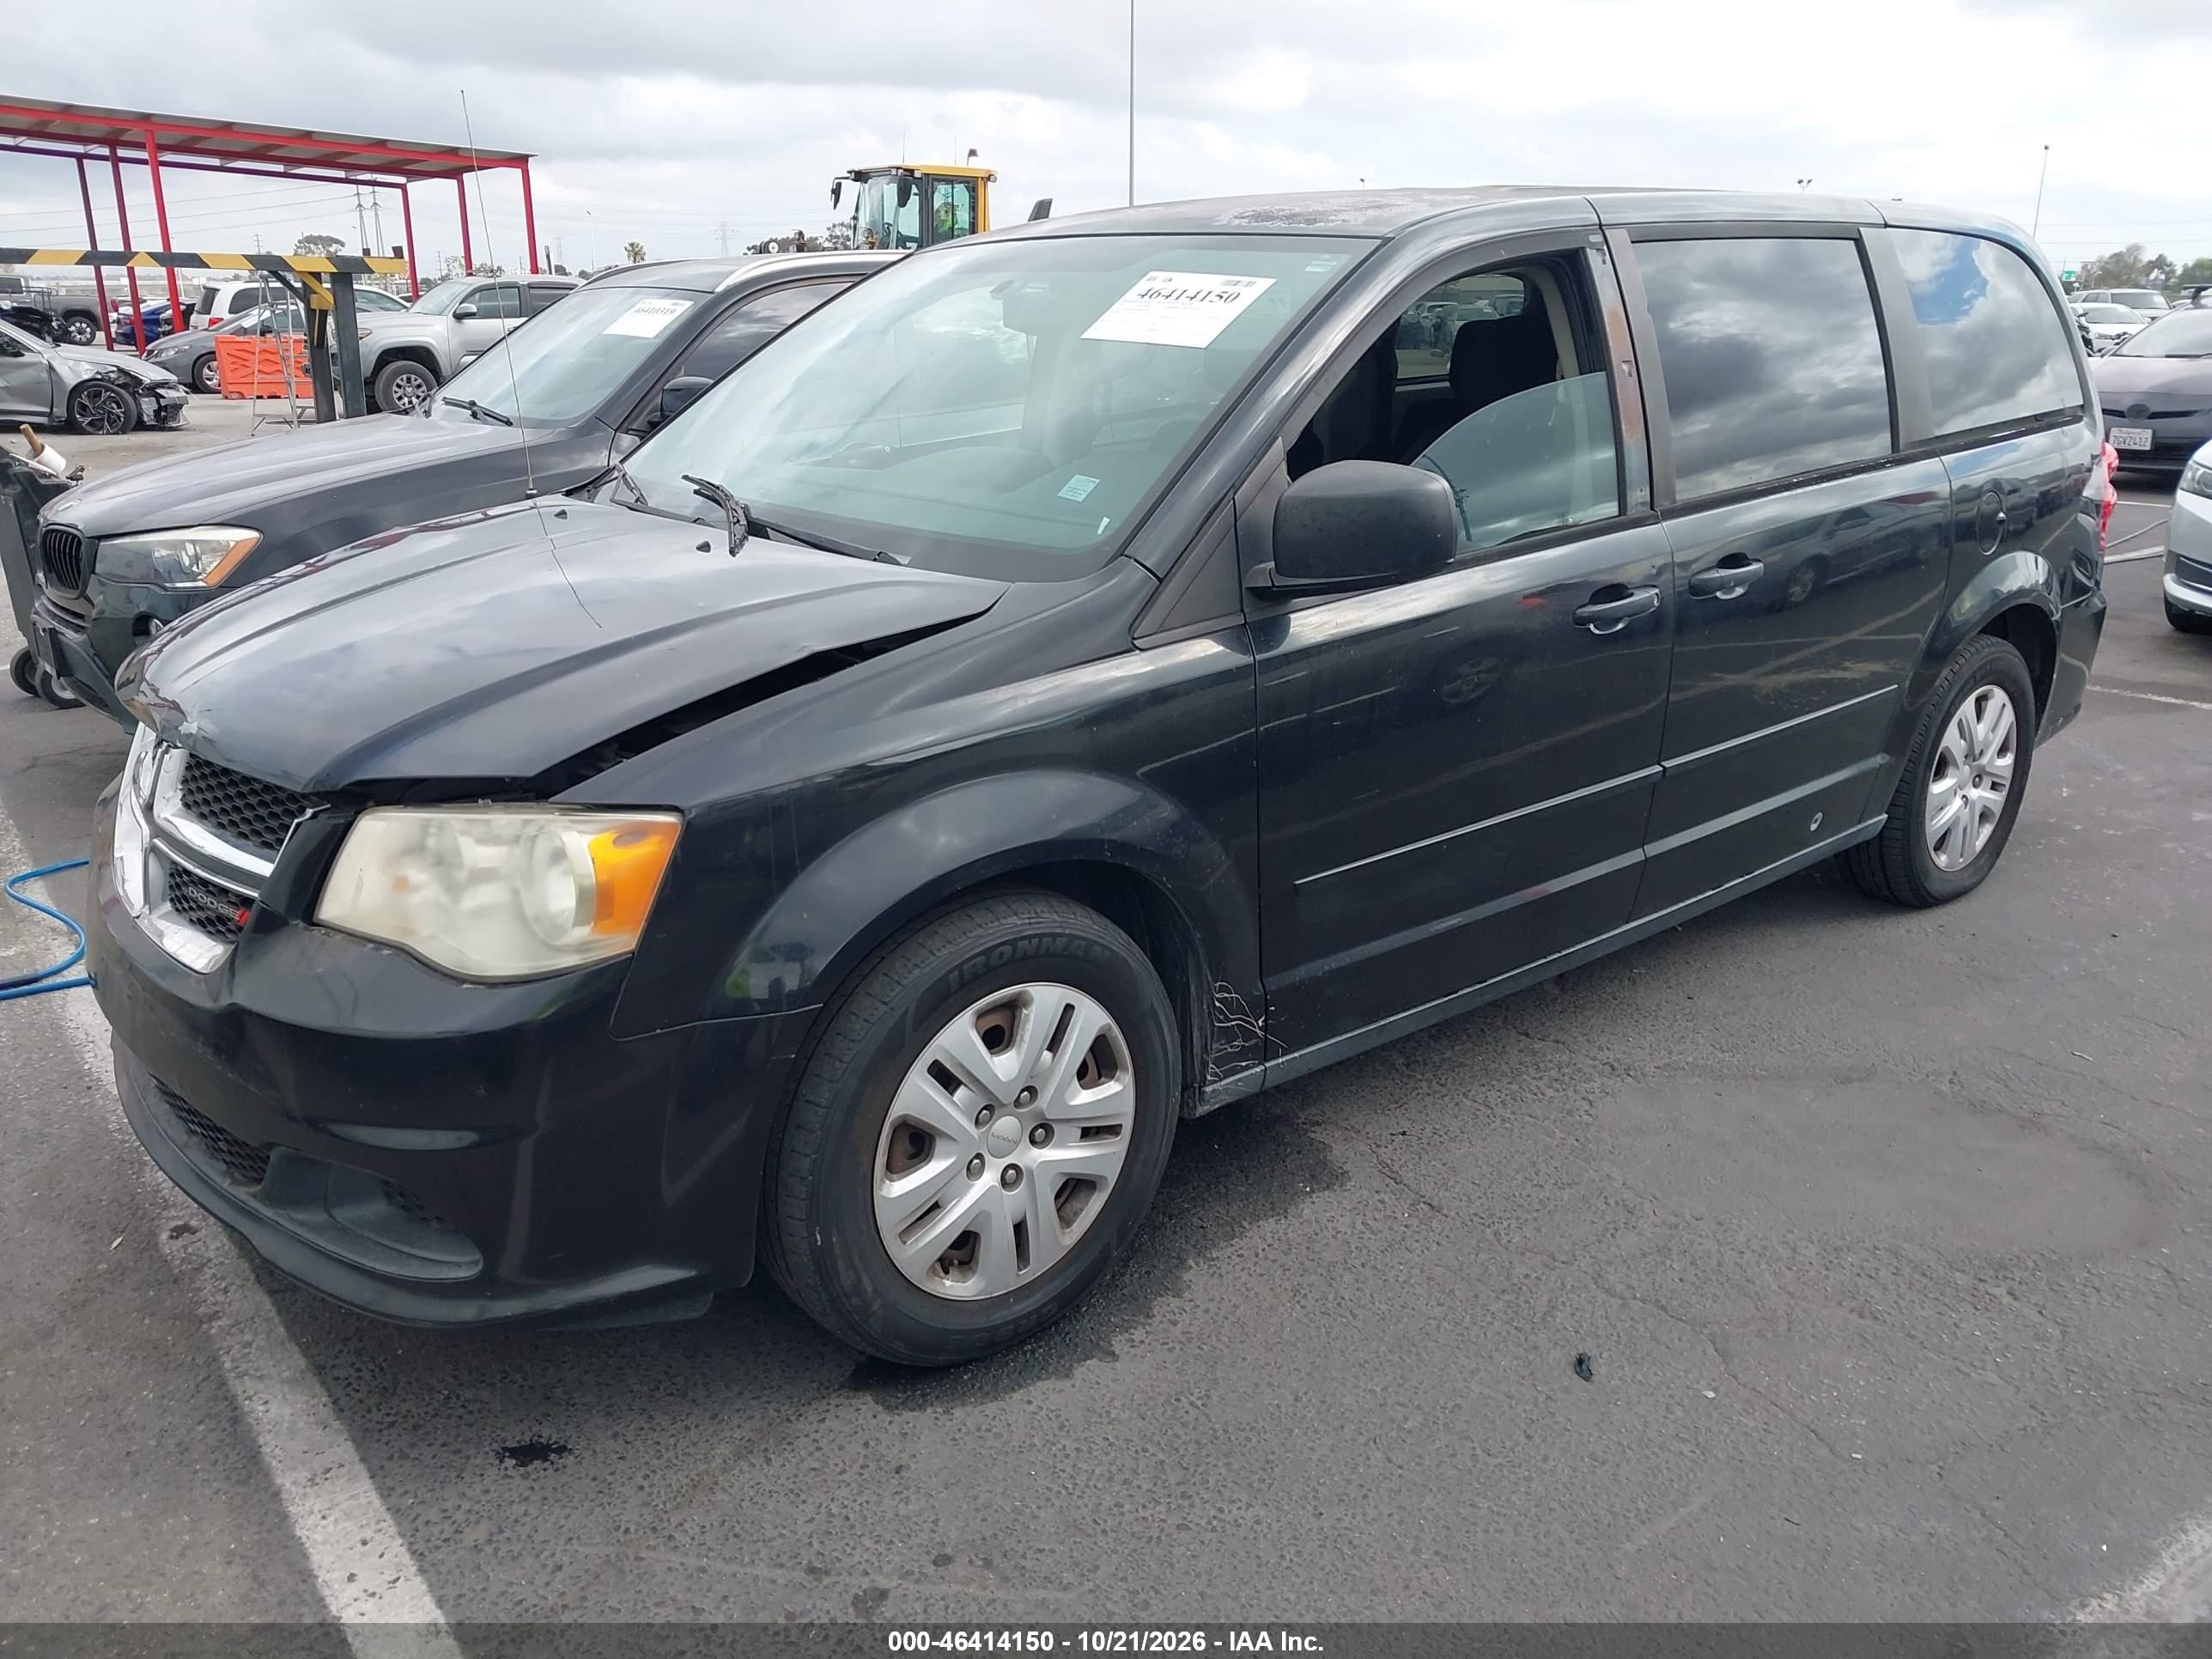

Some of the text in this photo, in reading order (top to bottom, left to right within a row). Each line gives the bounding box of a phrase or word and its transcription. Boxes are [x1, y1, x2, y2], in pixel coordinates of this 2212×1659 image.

[1136, 287, 1242, 304] 46414150
[2112, 434, 2149, 447] 7GVZ412
[188, 886, 240, 921] DODGE
[947, 937, 1113, 993] IRONMAN
